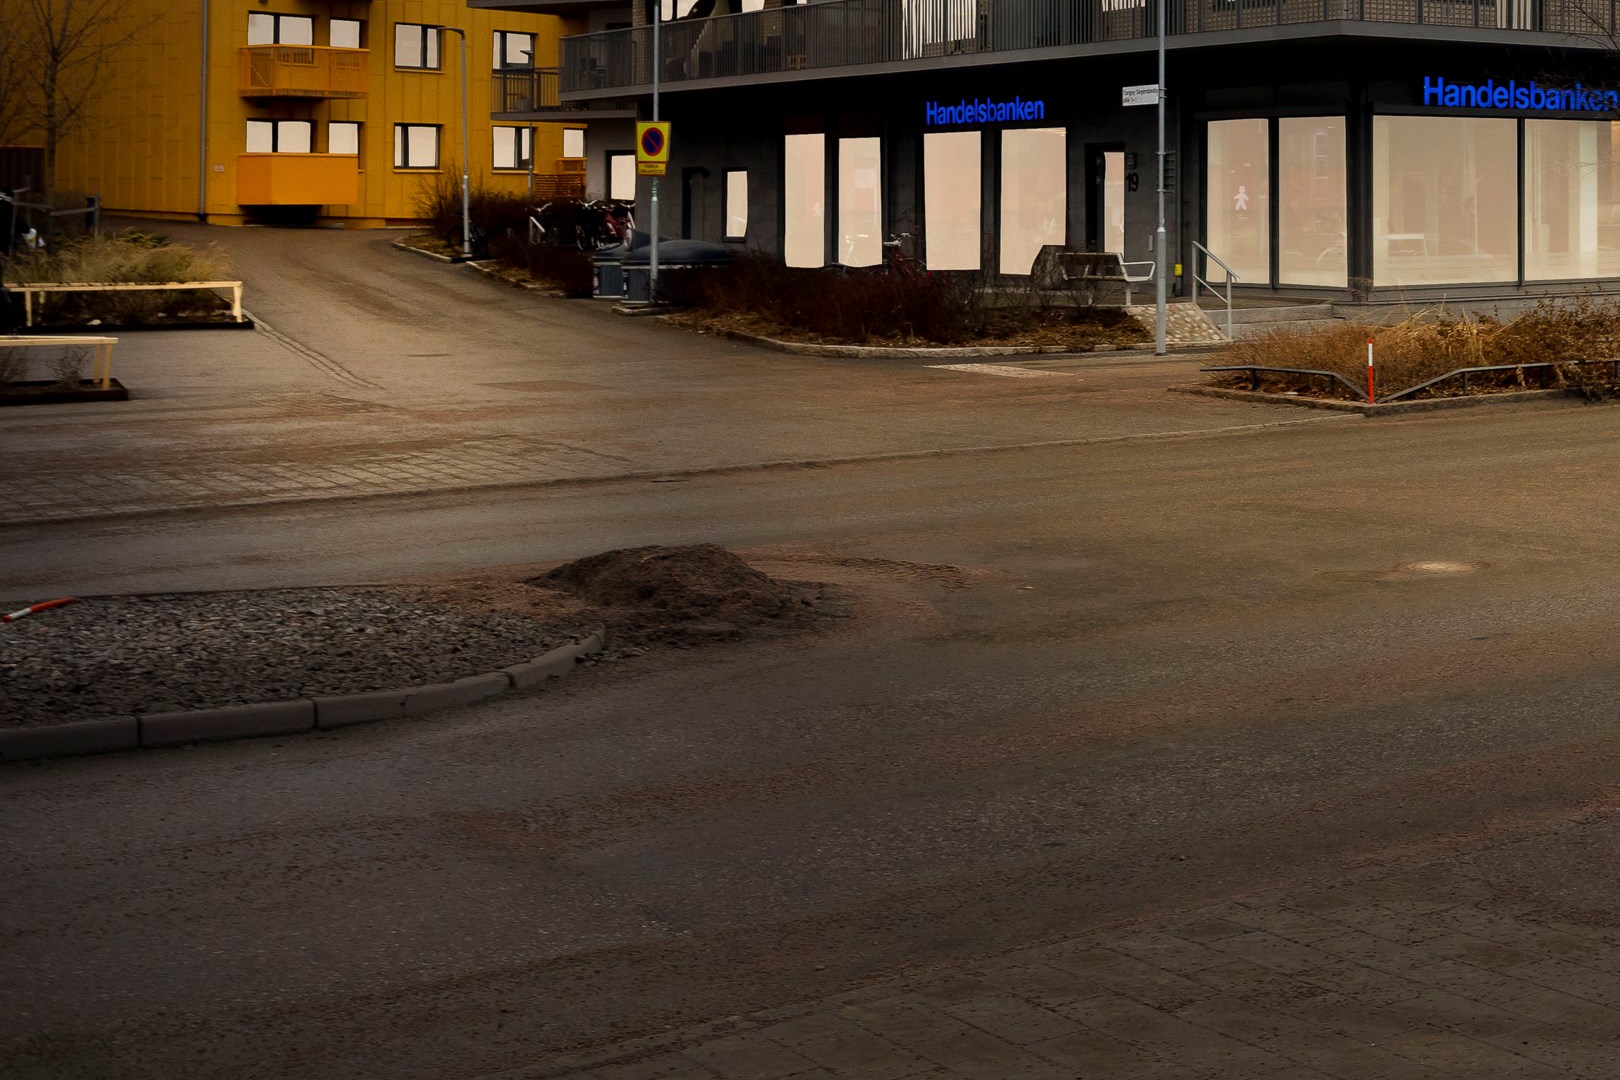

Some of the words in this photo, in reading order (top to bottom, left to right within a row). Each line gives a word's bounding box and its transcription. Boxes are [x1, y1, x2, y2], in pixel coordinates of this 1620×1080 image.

[1423, 76, 1619, 111] Handelsbanken
[926, 95, 1045, 125] Handelsbanken
[1126, 171, 1139, 193] 19
